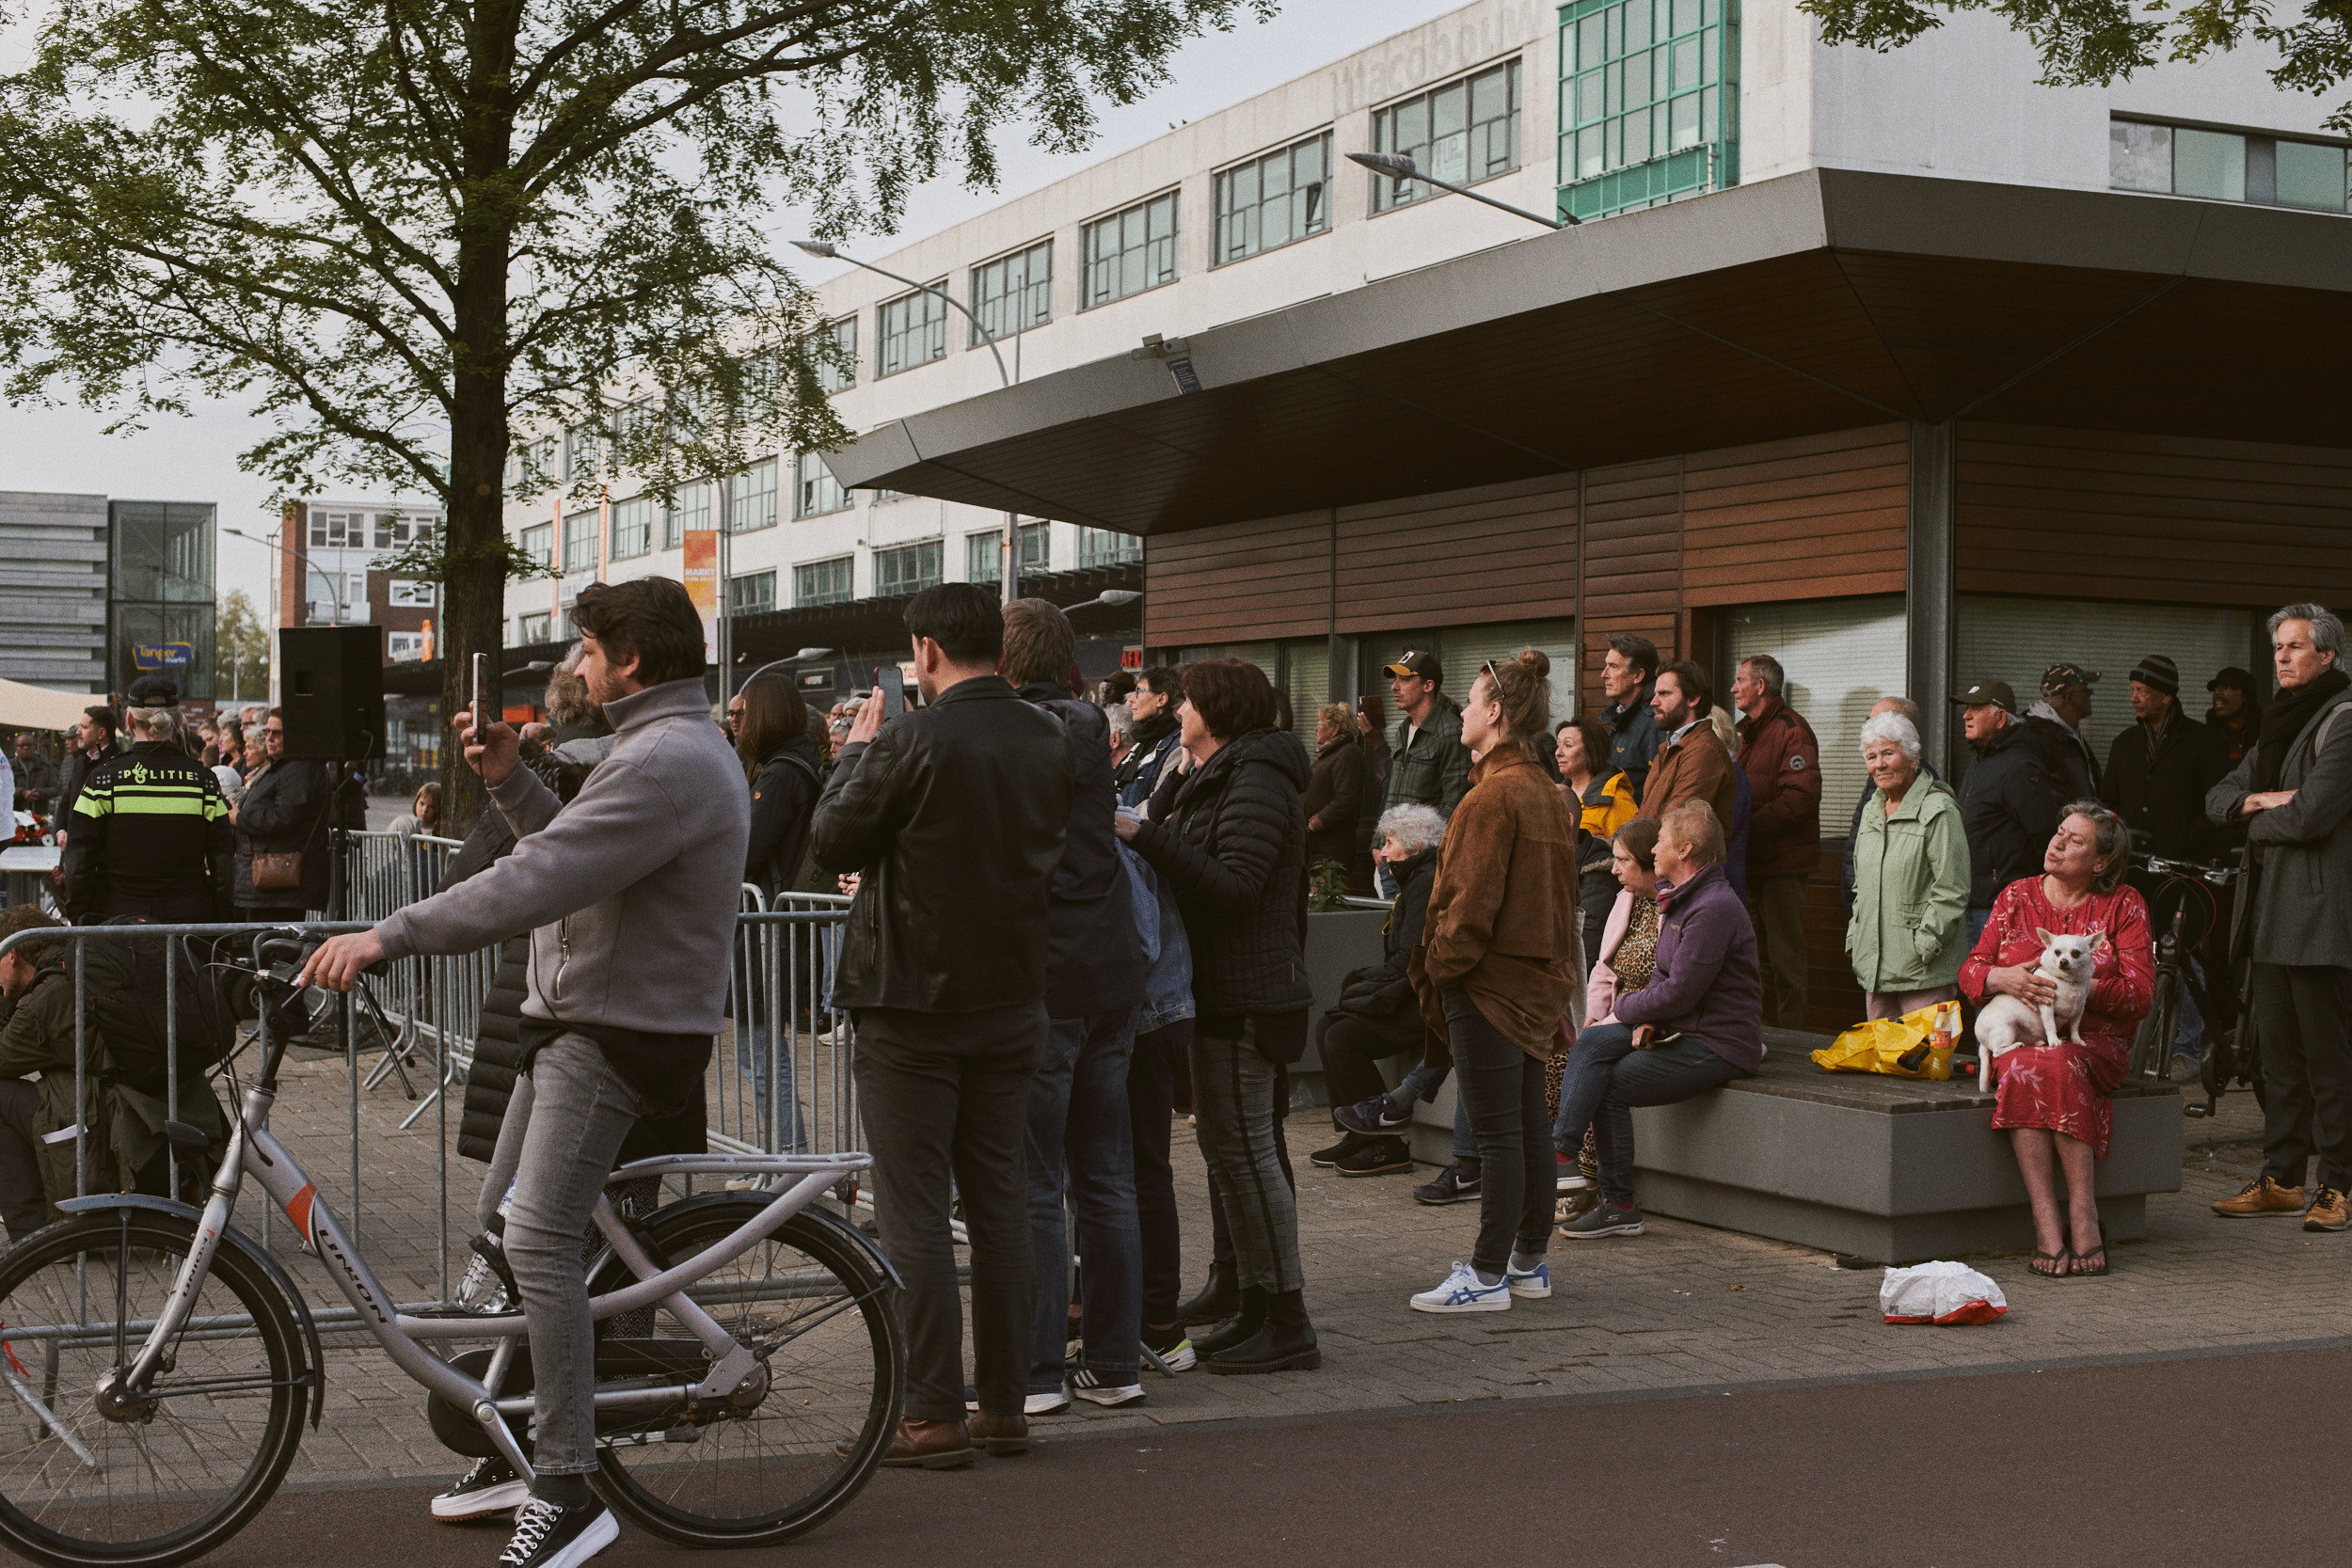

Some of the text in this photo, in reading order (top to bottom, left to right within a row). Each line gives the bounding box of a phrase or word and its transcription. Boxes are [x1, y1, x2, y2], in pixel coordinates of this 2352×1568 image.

[1120, 649, 1143, 667] AFR
[123, 766, 195, 784] POLITIE
[183, 1237, 208, 1298] UNION
[318, 1228, 388, 1323] UNION
